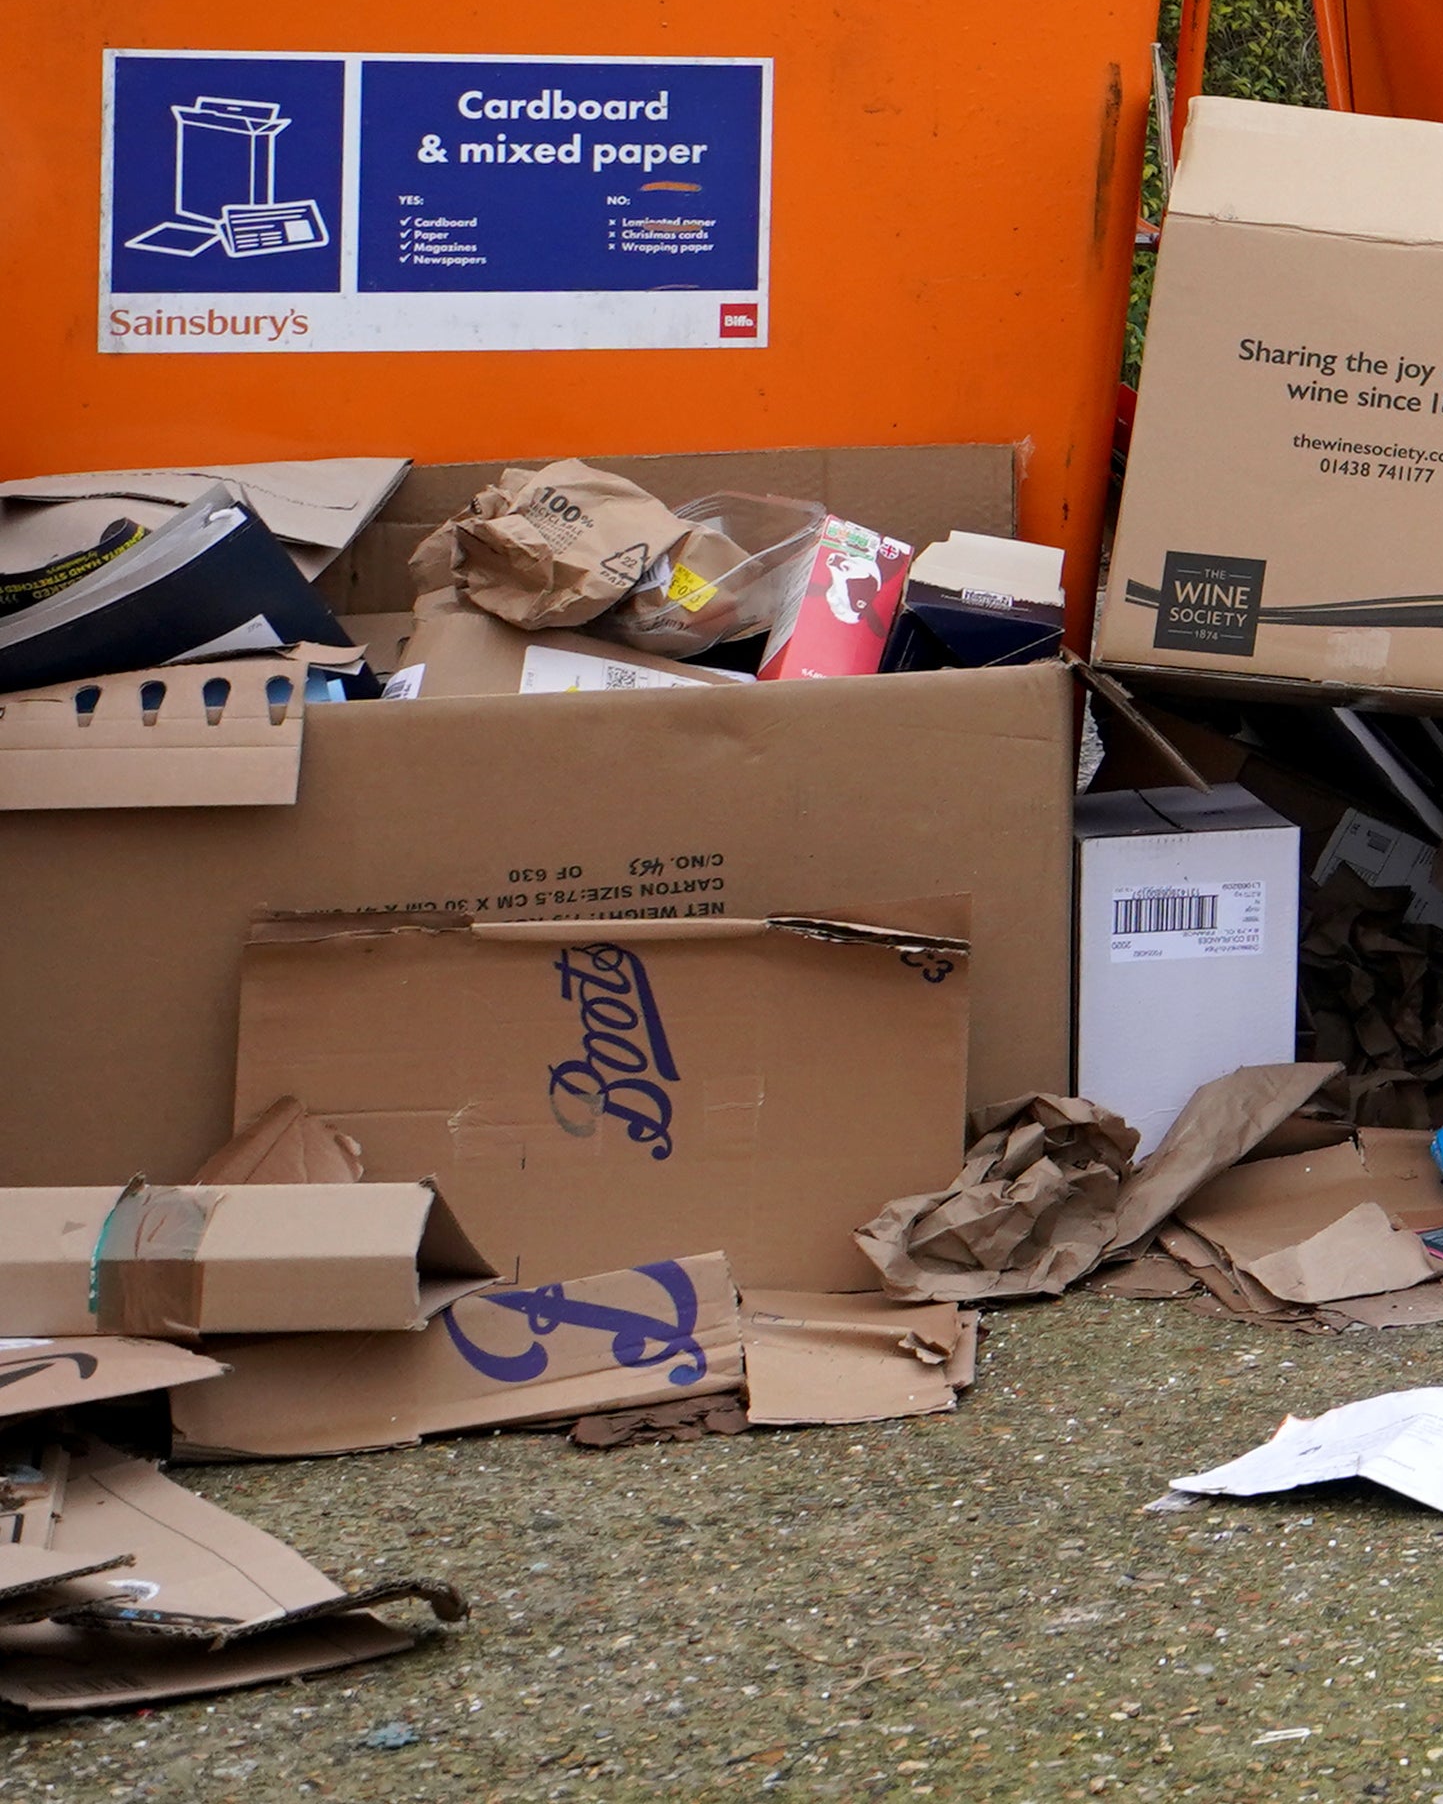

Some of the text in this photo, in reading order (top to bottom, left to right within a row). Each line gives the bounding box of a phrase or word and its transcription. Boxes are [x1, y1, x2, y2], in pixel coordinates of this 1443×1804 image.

[458, 89, 668, 121] Cardboard
[417, 133, 707, 172] & mixed paper
[399, 196, 423, 205] YES:
[607, 196, 630, 205] NO:
[413, 217, 477, 227] Cardboard
[414, 230, 449, 241] Paper
[621, 230, 708, 240] Christmas cards
[413, 242, 477, 253] Magazines
[622, 242, 714, 253] Wrapping paper
[413, 254, 487, 265] Newspapers
[109, 306, 308, 342] Sainsbury's
[725, 315, 754, 327] Biffa
[1238, 338, 1338, 375] Sharing
[1346, 352, 1388, 375] the
[1394, 357, 1436, 386] joy
[1287, 381, 1349, 405] wine
[1357, 387, 1422, 413] since
[1320, 458, 1436, 484] 01438 741177
[540, 487, 595, 530] 100%
[69, 559, 101, 576] HAND
[621, 556, 638, 568] 22
[1205, 568, 1227, 580] THE
[1174, 580, 1251, 610] WINE
[1169, 607, 1248, 627] SOCIETY
[1194, 629, 1219, 641] 1874
[671, 854, 723, 867] C/NO.
[508, 869, 547, 883] 630
[556, 865, 582, 880] OF
[641, 878, 724, 896] CARTON
[497, 895, 528, 910] CM
[684, 902, 724, 918] NET
